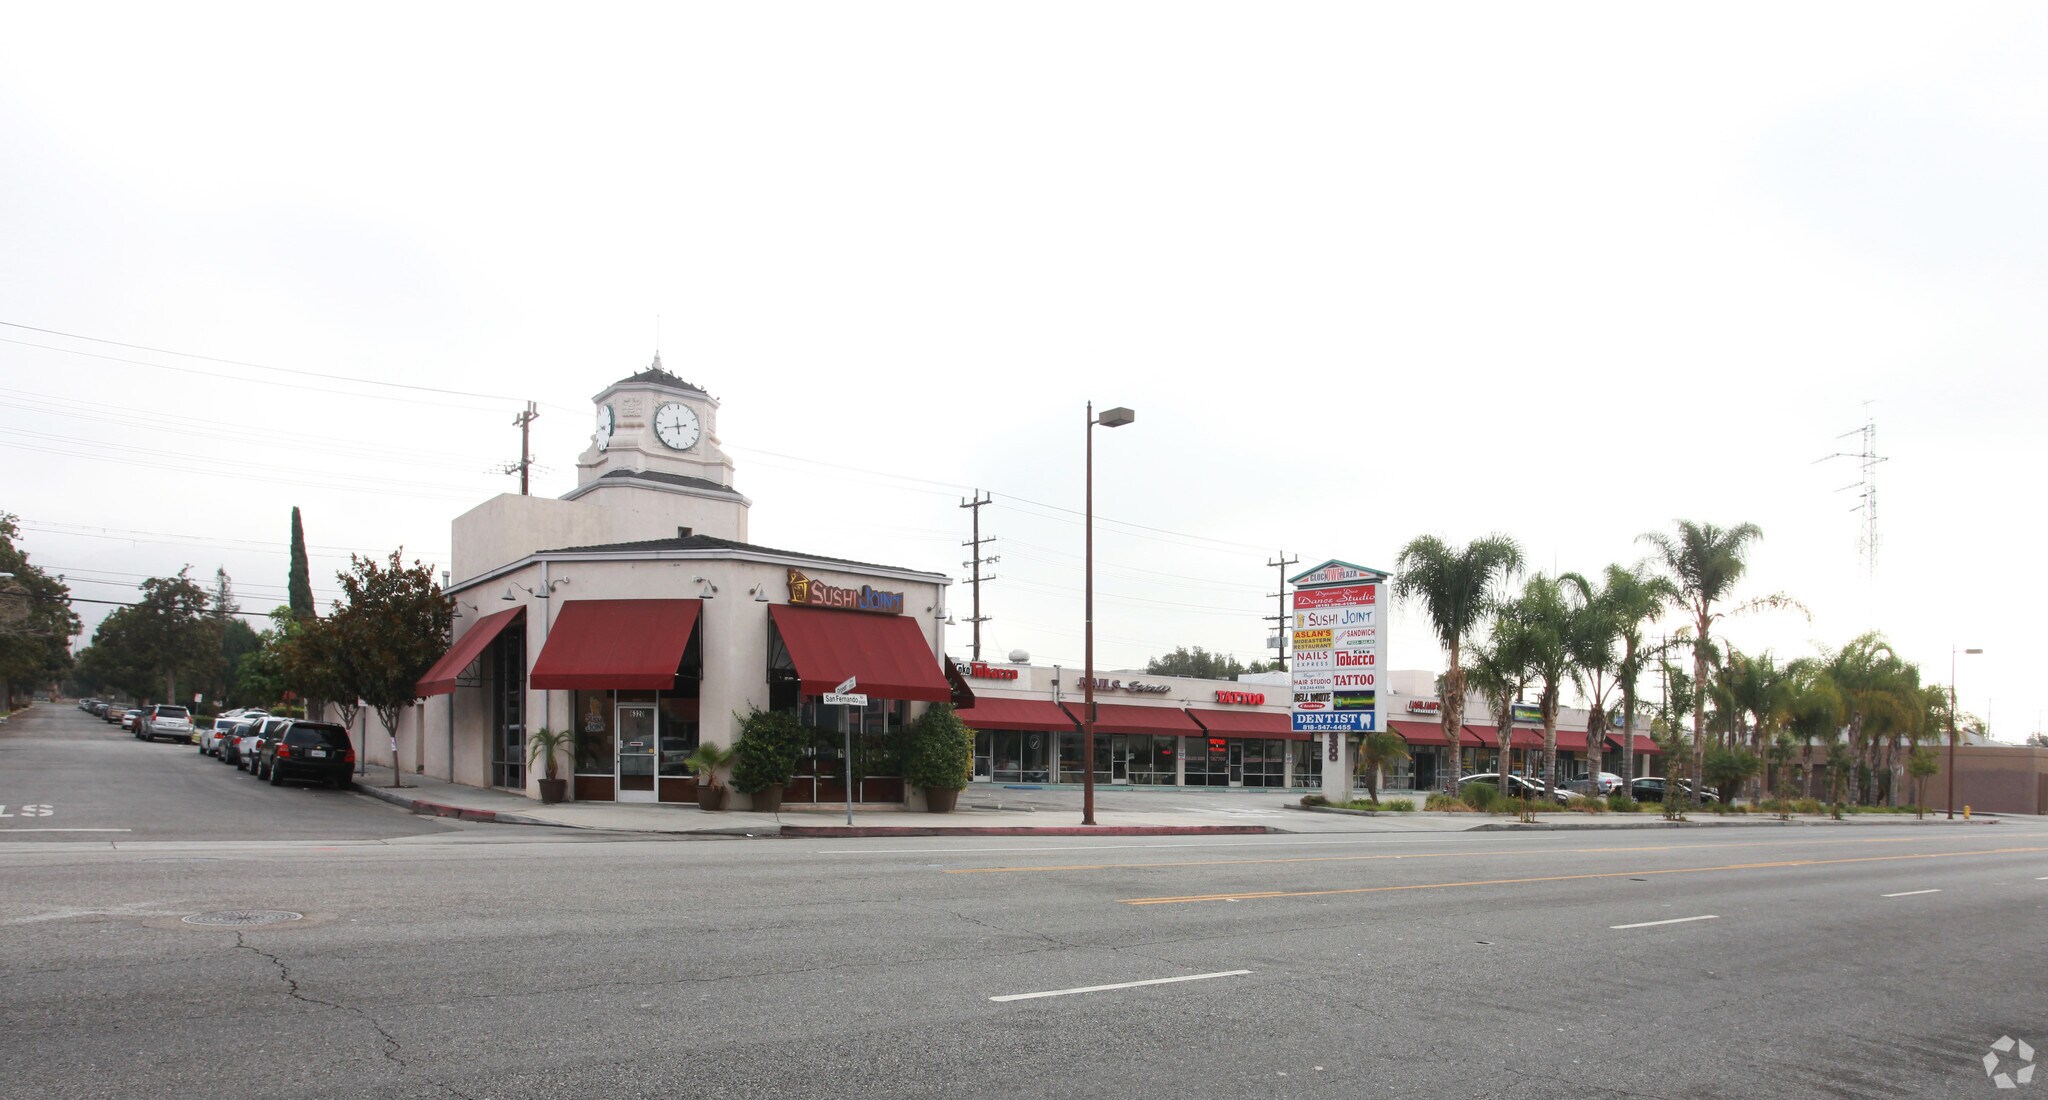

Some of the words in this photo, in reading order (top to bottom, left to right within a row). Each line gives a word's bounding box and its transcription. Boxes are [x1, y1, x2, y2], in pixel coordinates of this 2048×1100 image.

[1339, 570, 1357, 579] PLAZA
[811, 580, 857, 608] SUSHI
[859, 585, 900, 609] JOINT
[1298, 596, 1333, 605] Dance
[1336, 591, 1375, 603] Studio
[1308, 612, 1338, 626] SUSHI
[1342, 609, 1372, 624] JOINT
[1295, 630, 1331, 638] ASLAN'S
[1347, 629, 1375, 637] SANDWICH
[1297, 651, 1328, 661] NAILS
[1335, 651, 1375, 666] Tobacco
[1333, 674, 1375, 685] TATTOO
[825, 694, 835, 703] San
[836, 695, 859, 703] Fernando
[1216, 690, 1265, 705] TATTOO
[1297, 713, 1357, 724] DENTIST
